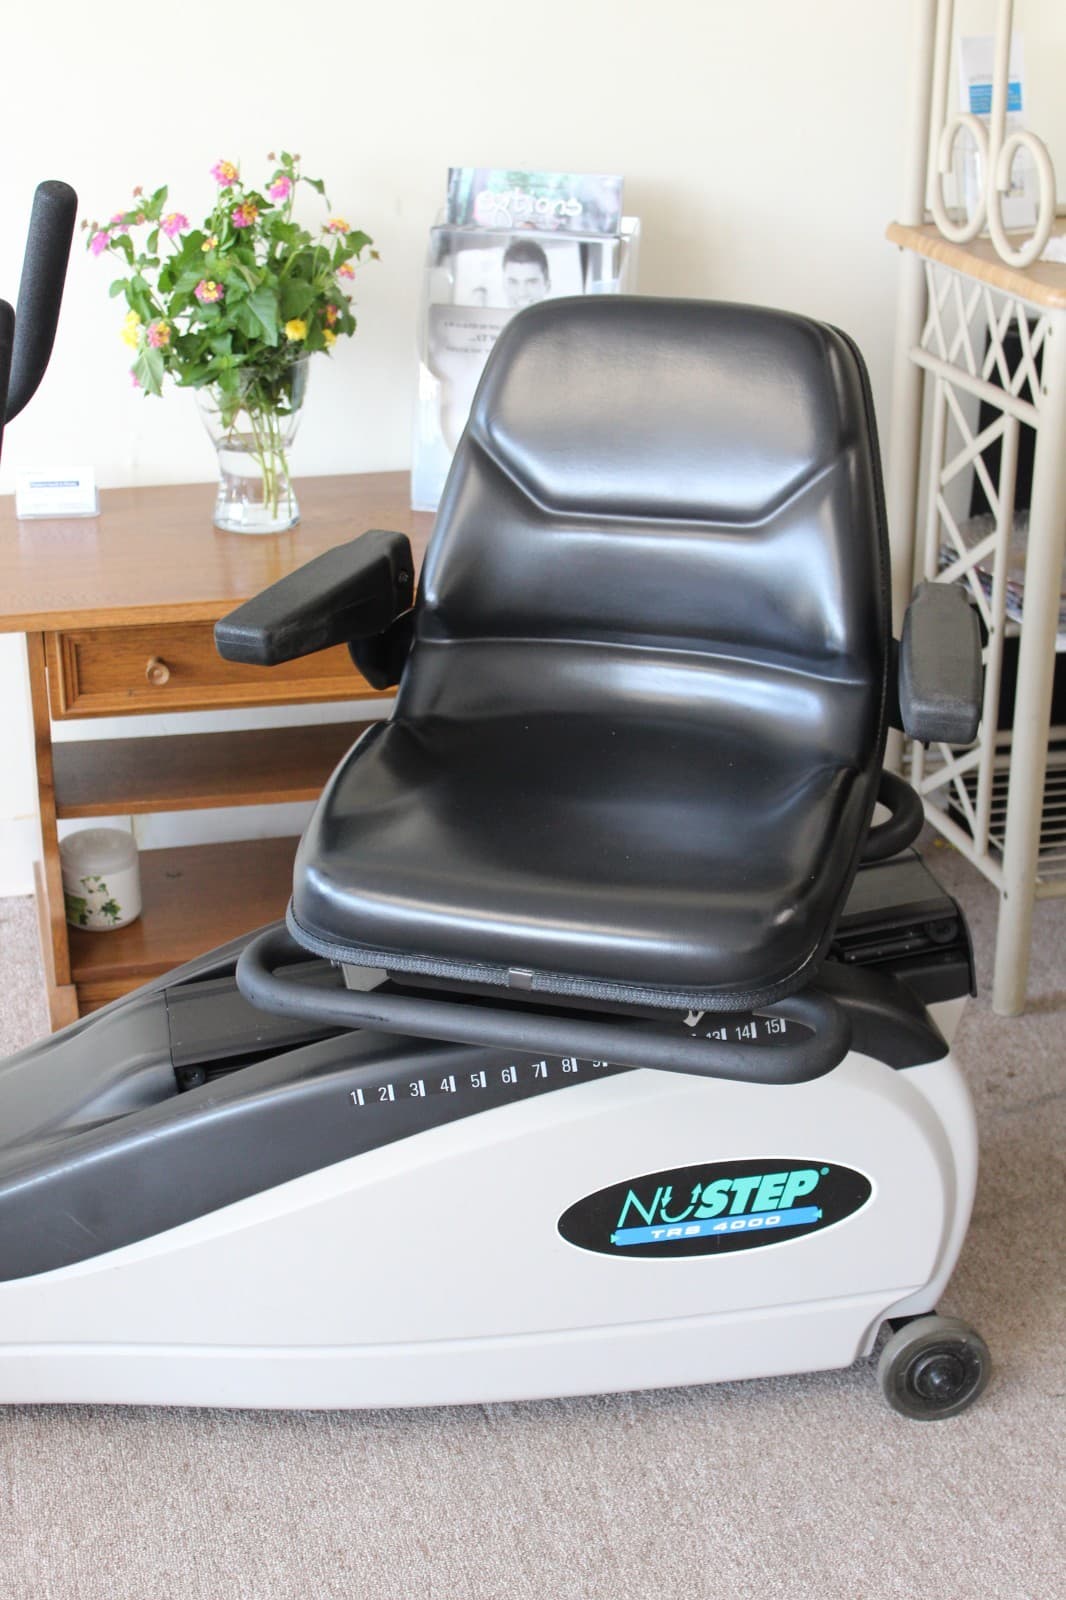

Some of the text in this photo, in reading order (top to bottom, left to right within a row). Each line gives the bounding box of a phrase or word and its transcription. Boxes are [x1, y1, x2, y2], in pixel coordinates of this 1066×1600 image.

[735, 1025, 751, 1040] 14
[764, 1018, 780, 1034] 15
[350, 1057, 571, 1105] 1 2 3 4 5 6 7 8
[651, 1215, 782, 1240] TRS 4000
